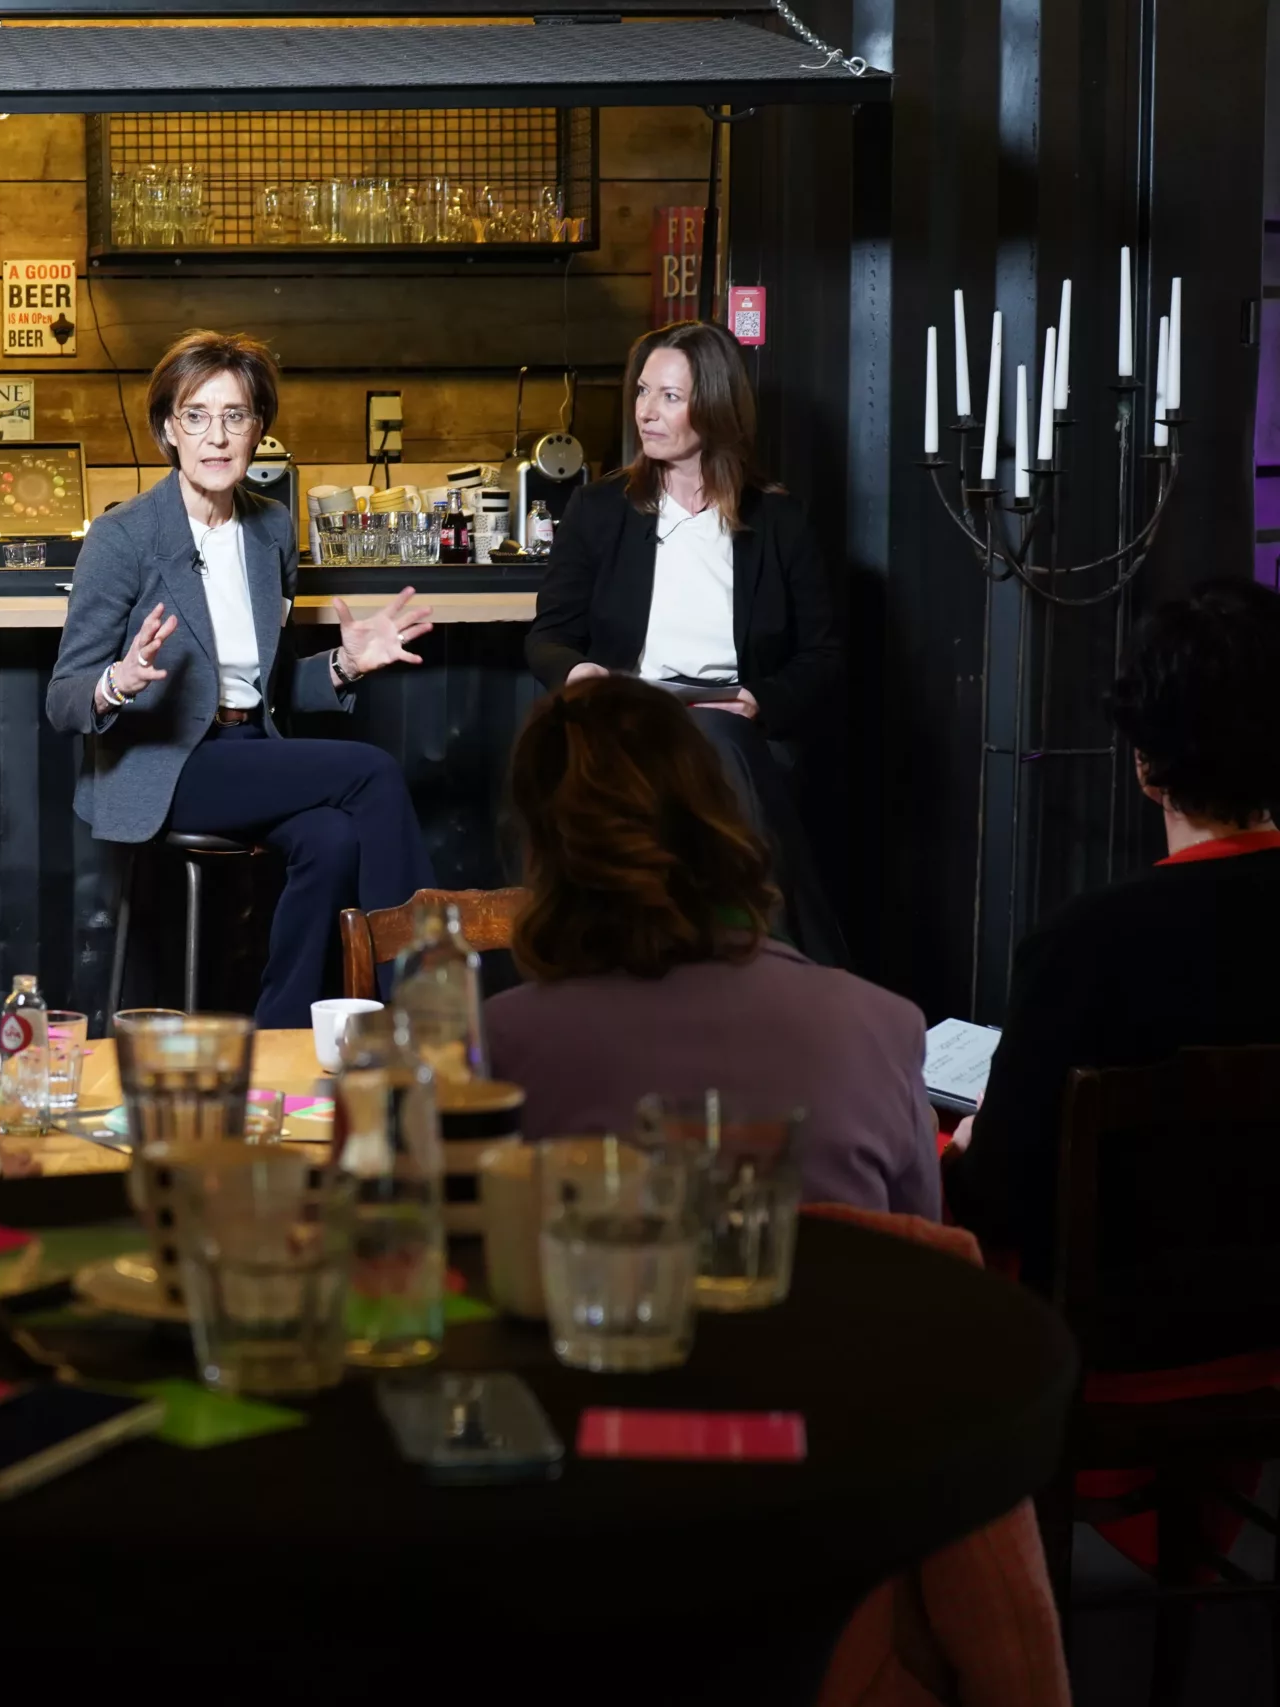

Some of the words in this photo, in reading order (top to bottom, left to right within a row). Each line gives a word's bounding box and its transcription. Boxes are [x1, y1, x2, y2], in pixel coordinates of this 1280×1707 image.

[9, 265, 19, 279] A
[26, 265, 71, 279] GOOD
[9, 284, 71, 308] BEER
[8, 313, 16, 324] IS
[19, 313, 29, 324] AN
[32, 313, 53, 324] OPEN
[9, 330, 43, 348] BEER
